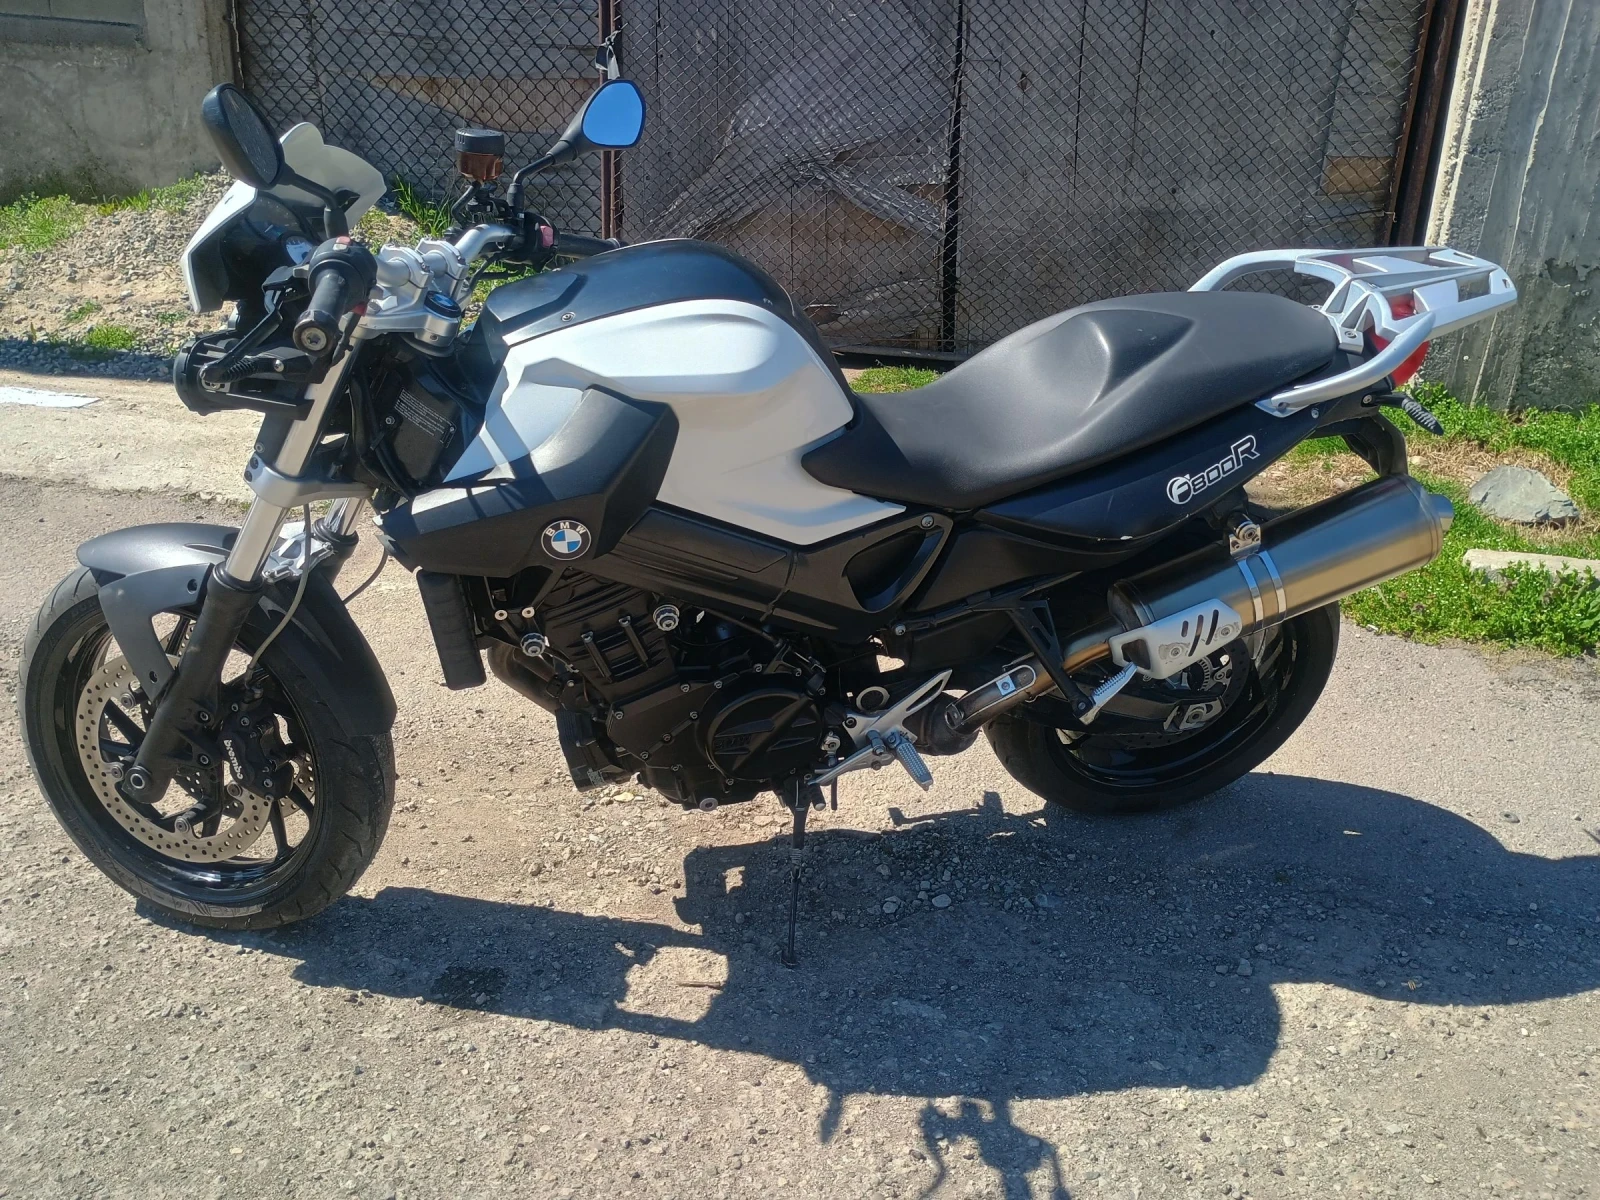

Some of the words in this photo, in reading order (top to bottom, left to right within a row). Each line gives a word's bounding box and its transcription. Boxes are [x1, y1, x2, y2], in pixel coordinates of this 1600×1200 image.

[1166, 434, 1261, 505] F800R
[545, 521, 587, 537] BMW
[223, 739, 244, 780] brembo
